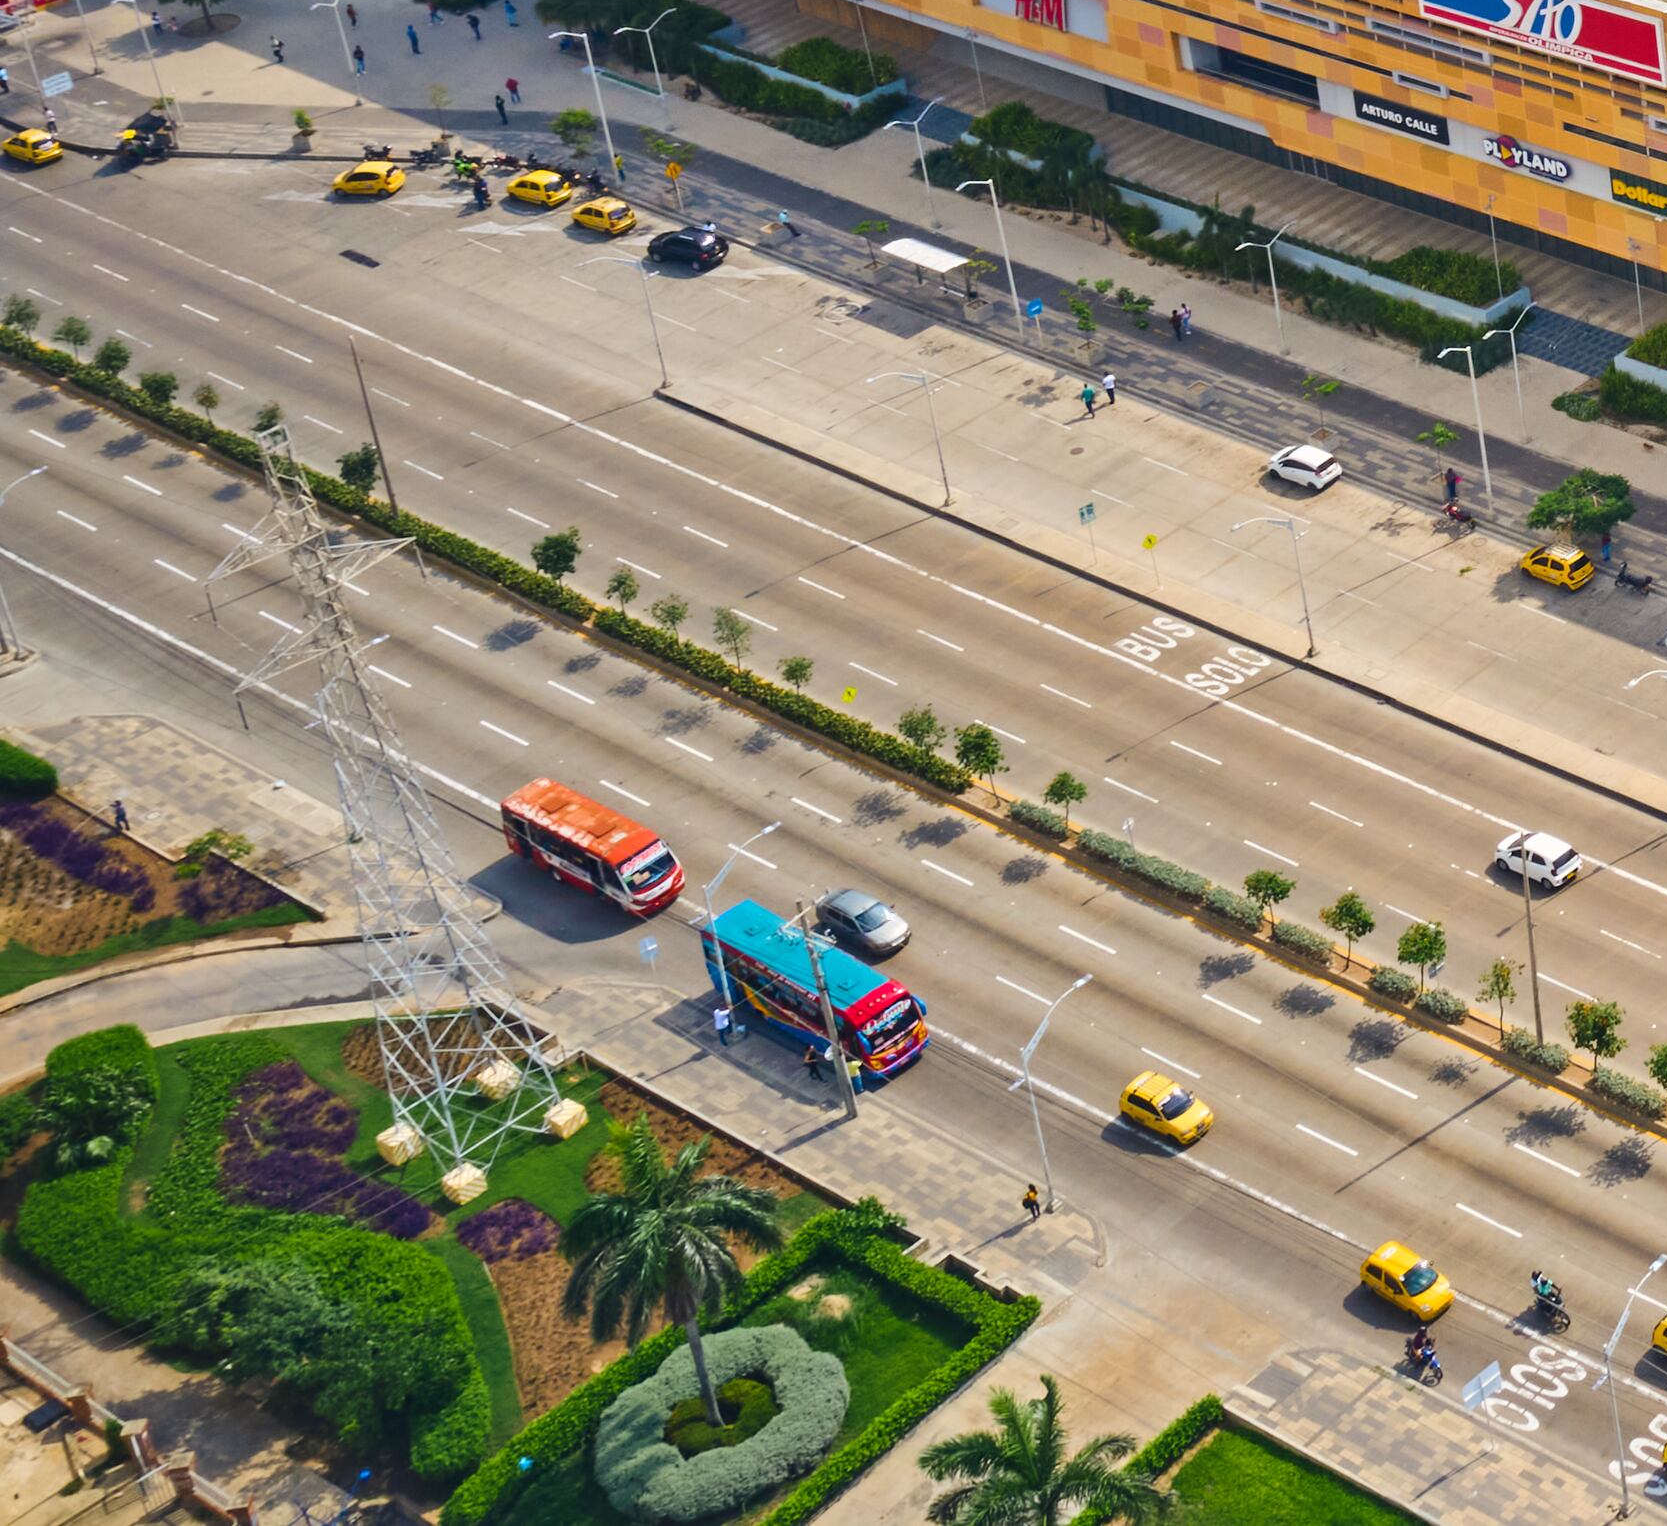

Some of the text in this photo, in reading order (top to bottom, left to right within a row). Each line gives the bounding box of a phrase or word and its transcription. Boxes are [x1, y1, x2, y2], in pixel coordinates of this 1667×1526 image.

[1361, 103, 1439, 136] ARTURO CALLE
[1113, 617, 1196, 663] BUS
[1185, 645, 1272, 696] SOLO
[1481, 1345, 1587, 1432] SOLO
